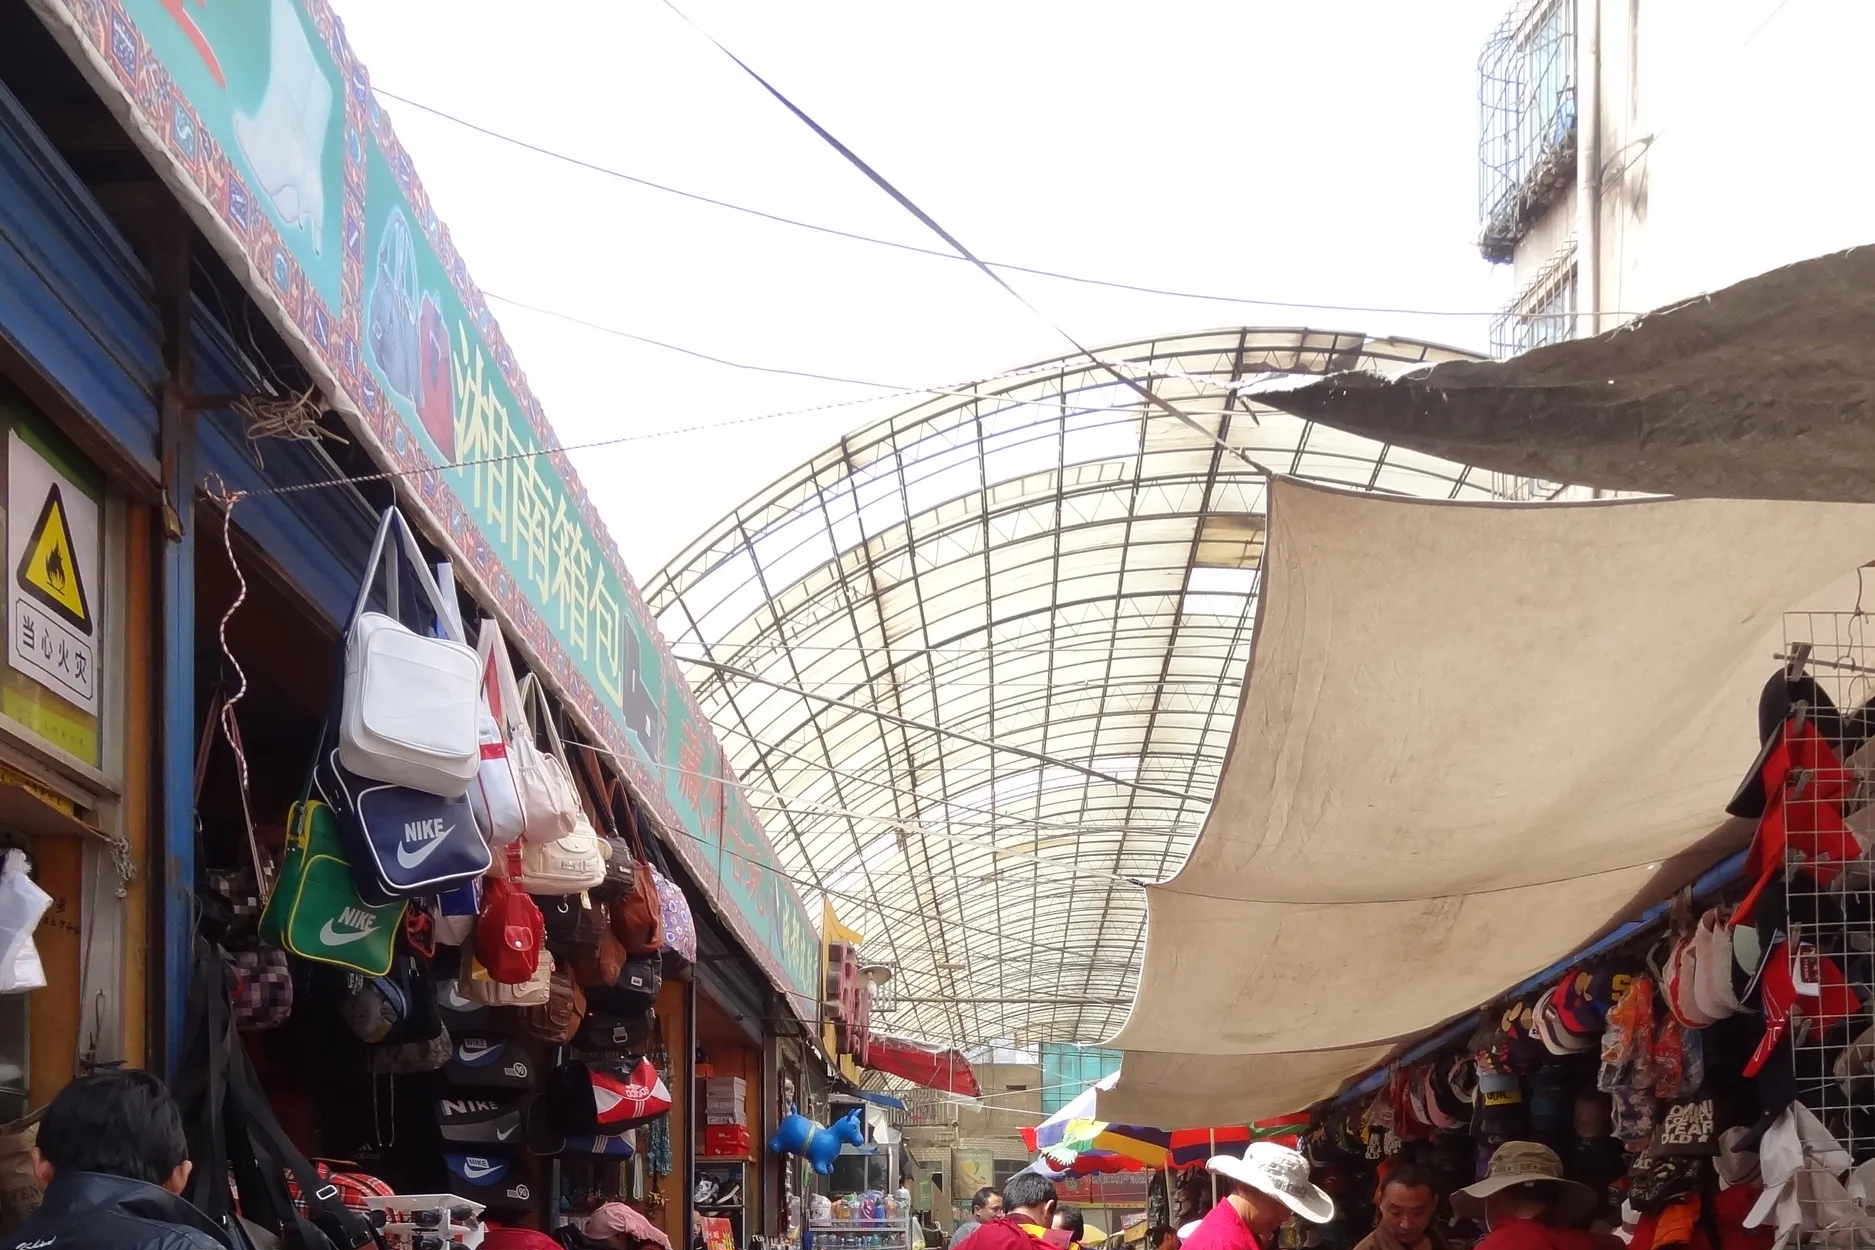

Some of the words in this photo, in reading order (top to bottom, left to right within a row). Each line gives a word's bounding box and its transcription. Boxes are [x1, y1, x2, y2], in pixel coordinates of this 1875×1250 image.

[453, 319, 623, 708] 湘南箱包
[22, 614, 87, 684] 当心火灾
[404, 818, 445, 842] NIKE
[338, 906, 376, 931] NIKE
[465, 1039, 487, 1048] NIKE
[442, 1100, 498, 1116] NIKE
[467, 1158, 488, 1167] NIKE
